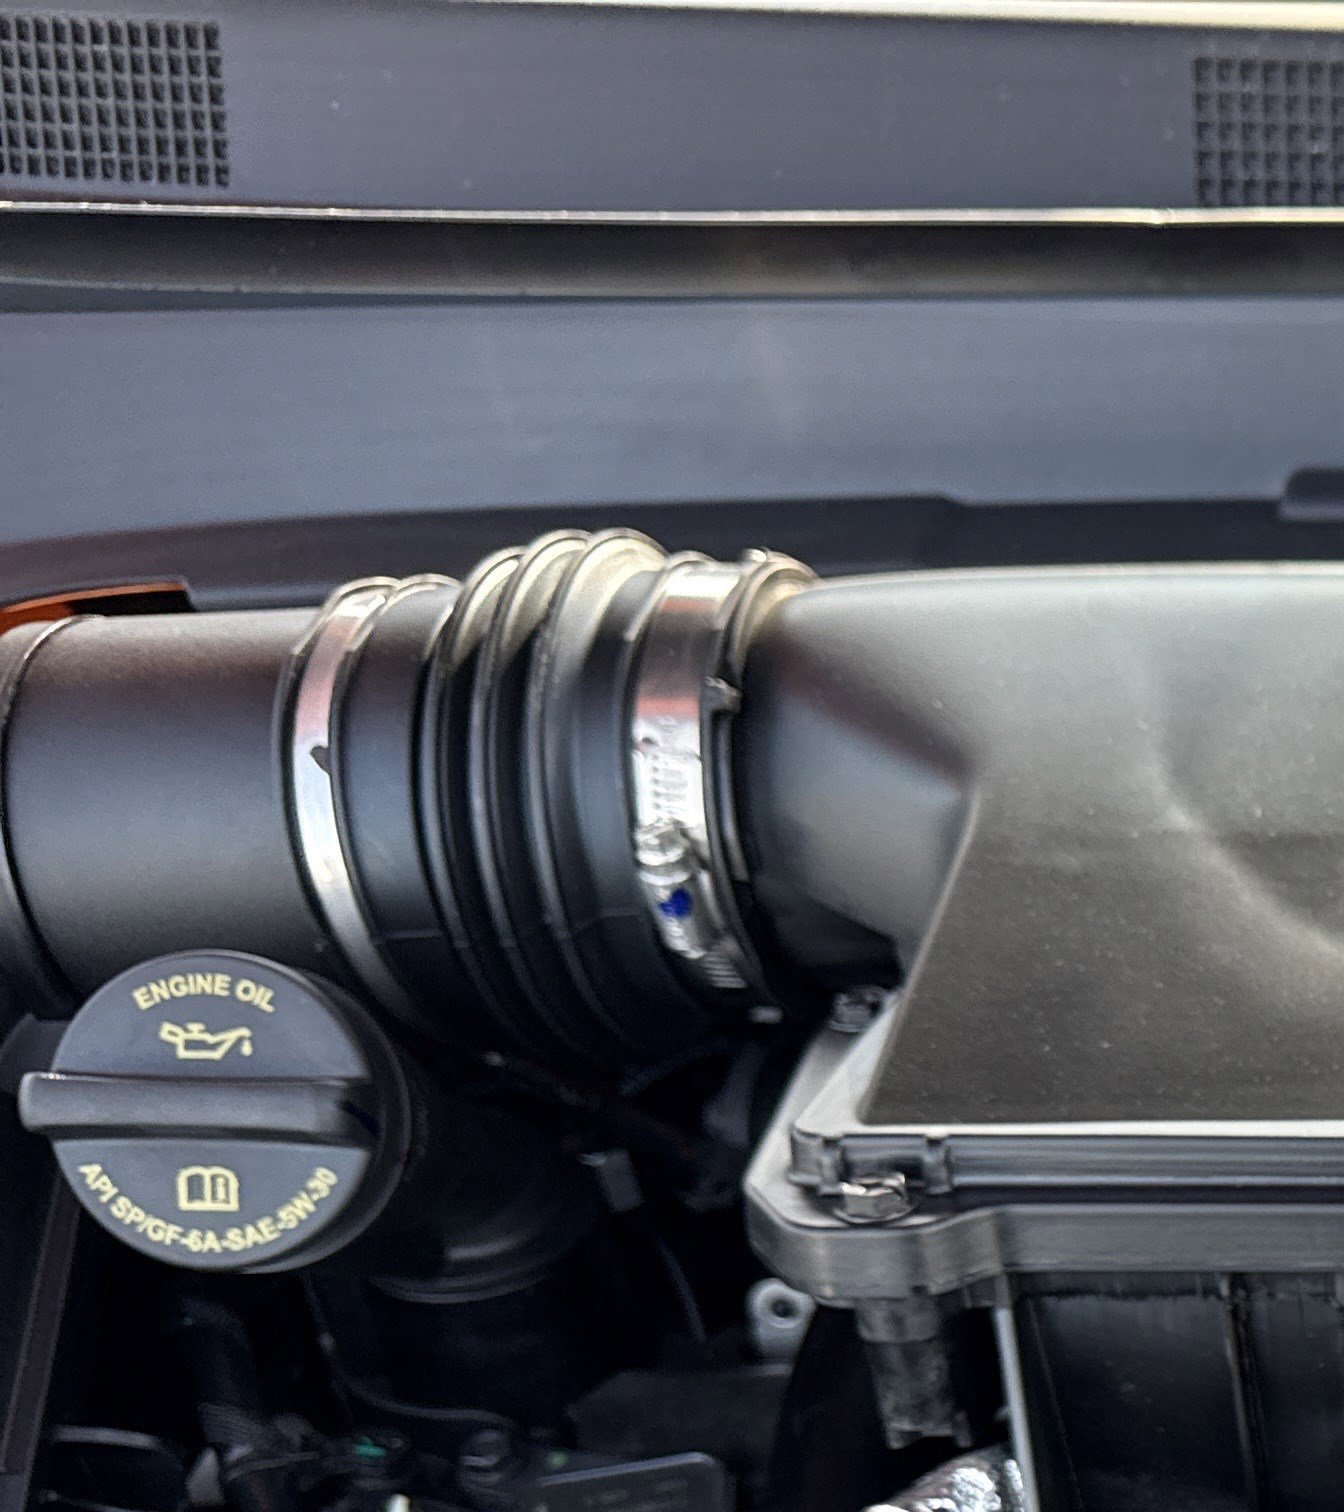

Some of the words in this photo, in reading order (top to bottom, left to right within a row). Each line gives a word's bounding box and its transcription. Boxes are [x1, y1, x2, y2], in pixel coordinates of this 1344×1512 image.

[132, 972, 232, 1010] ENGINE
[235, 979, 276, 1013] OIL
[79, 1163, 119, 1203] API
